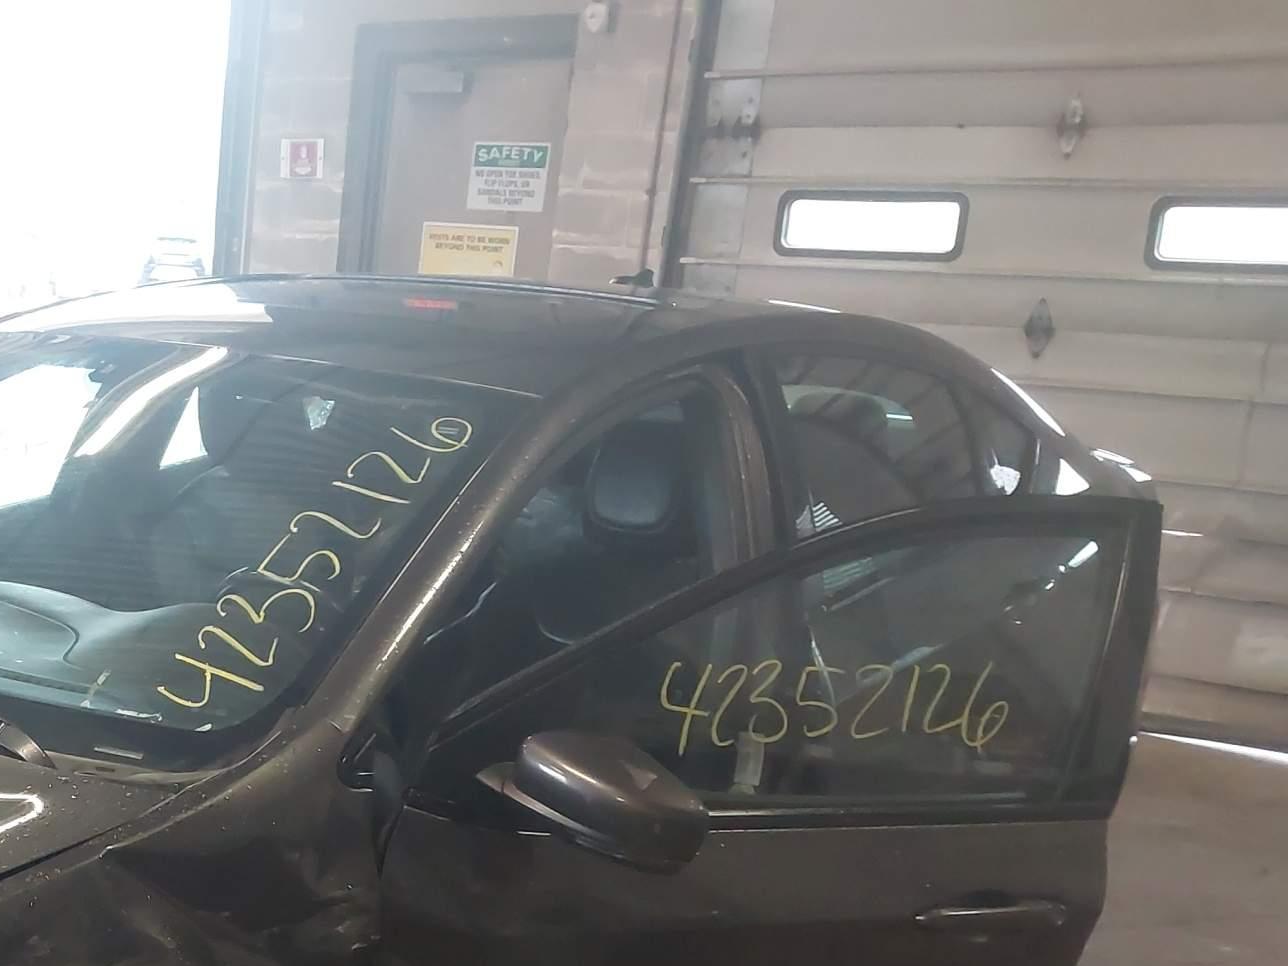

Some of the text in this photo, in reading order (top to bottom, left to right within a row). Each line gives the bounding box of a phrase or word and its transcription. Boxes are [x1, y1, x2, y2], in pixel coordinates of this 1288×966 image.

[477, 146, 544, 163] SAFETY
[156, 415, 474, 710] 42352126
[659, 658, 1010, 758] 42352126
